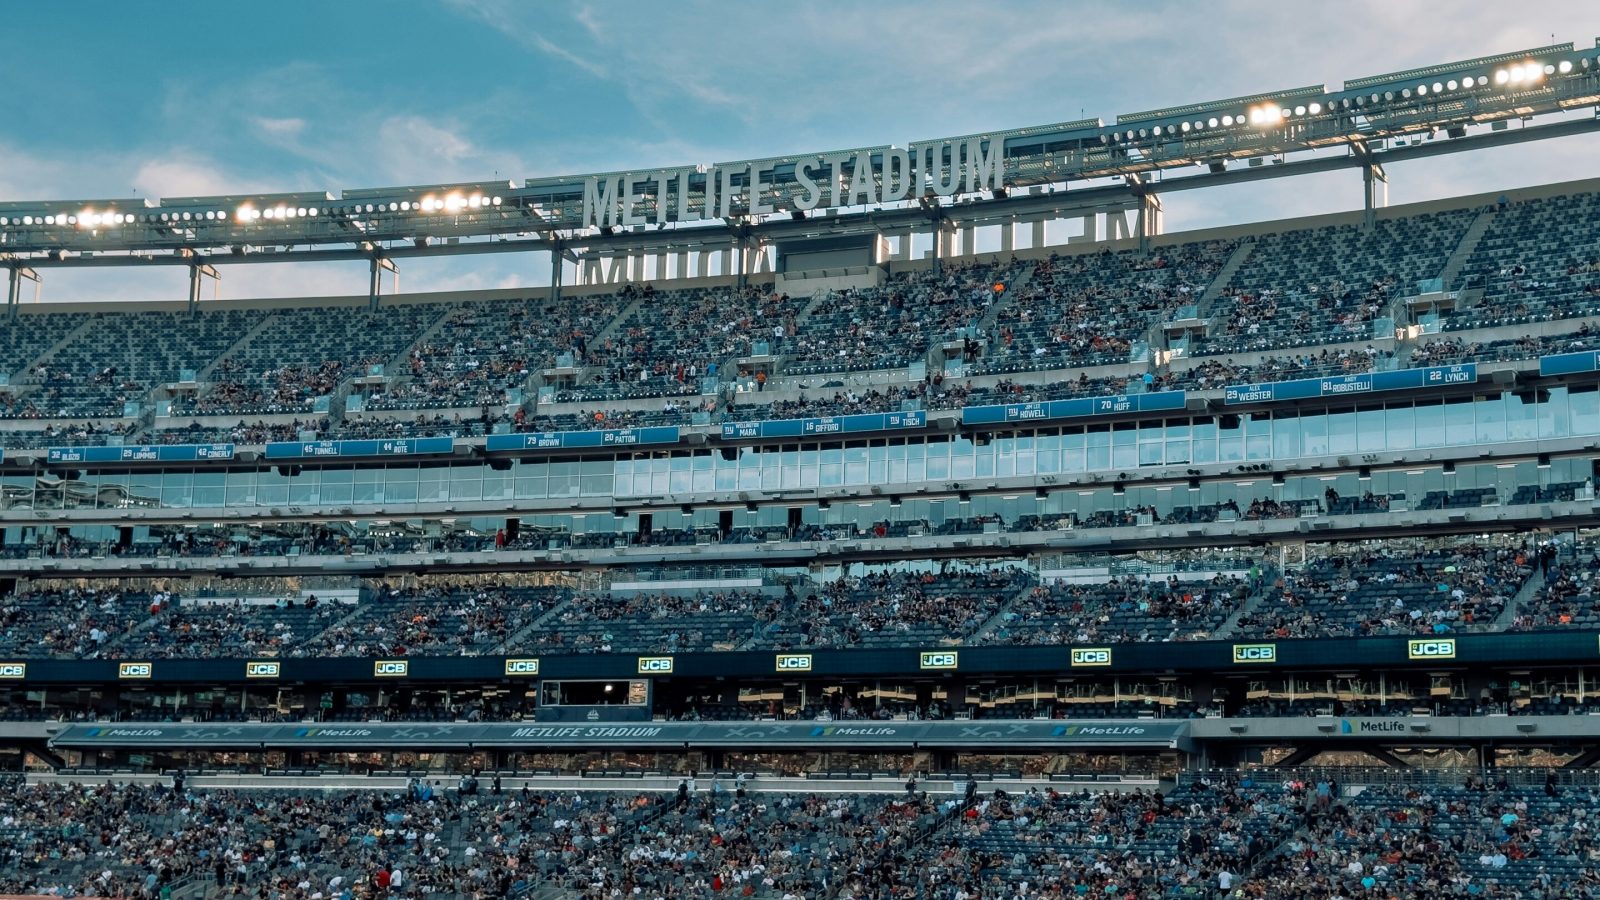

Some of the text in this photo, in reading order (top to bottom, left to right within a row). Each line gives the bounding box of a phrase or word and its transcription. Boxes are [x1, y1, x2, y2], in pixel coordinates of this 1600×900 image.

[583, 136, 1003, 227] METLIFE STADIUM
[1430, 371, 1468, 382] 22 LYNCH
[1323, 381, 1370, 392] 81 ROBUSTELLI
[1227, 390, 1271, 401] 29 WEBSTER
[1101, 401, 1130, 411] 70 HUFF
[1020, 409, 1045, 418] HOWELL
[806, 422, 838, 432] 16 GIFFORD
[903, 418, 919, 426] TISCH
[615, 435, 635, 443] PATTON
[314, 447, 337, 455] TUNNELL
[1237, 647, 1272, 659] JCB
[1412, 643, 1451, 655] JCB
[923, 655, 955, 665] JCB
[1075, 652, 1108, 662] JCB
[508, 663, 536, 672] JCB
[641, 660, 670, 670] JCB
[779, 657, 808, 668] JCB
[121, 666, 149, 675] JCB
[250, 665, 277, 674] JCB
[377, 664, 405, 673] JCB
[1360, 721, 1404, 731] MetLife
[511, 727, 662, 737] METLIFE STADIUM
